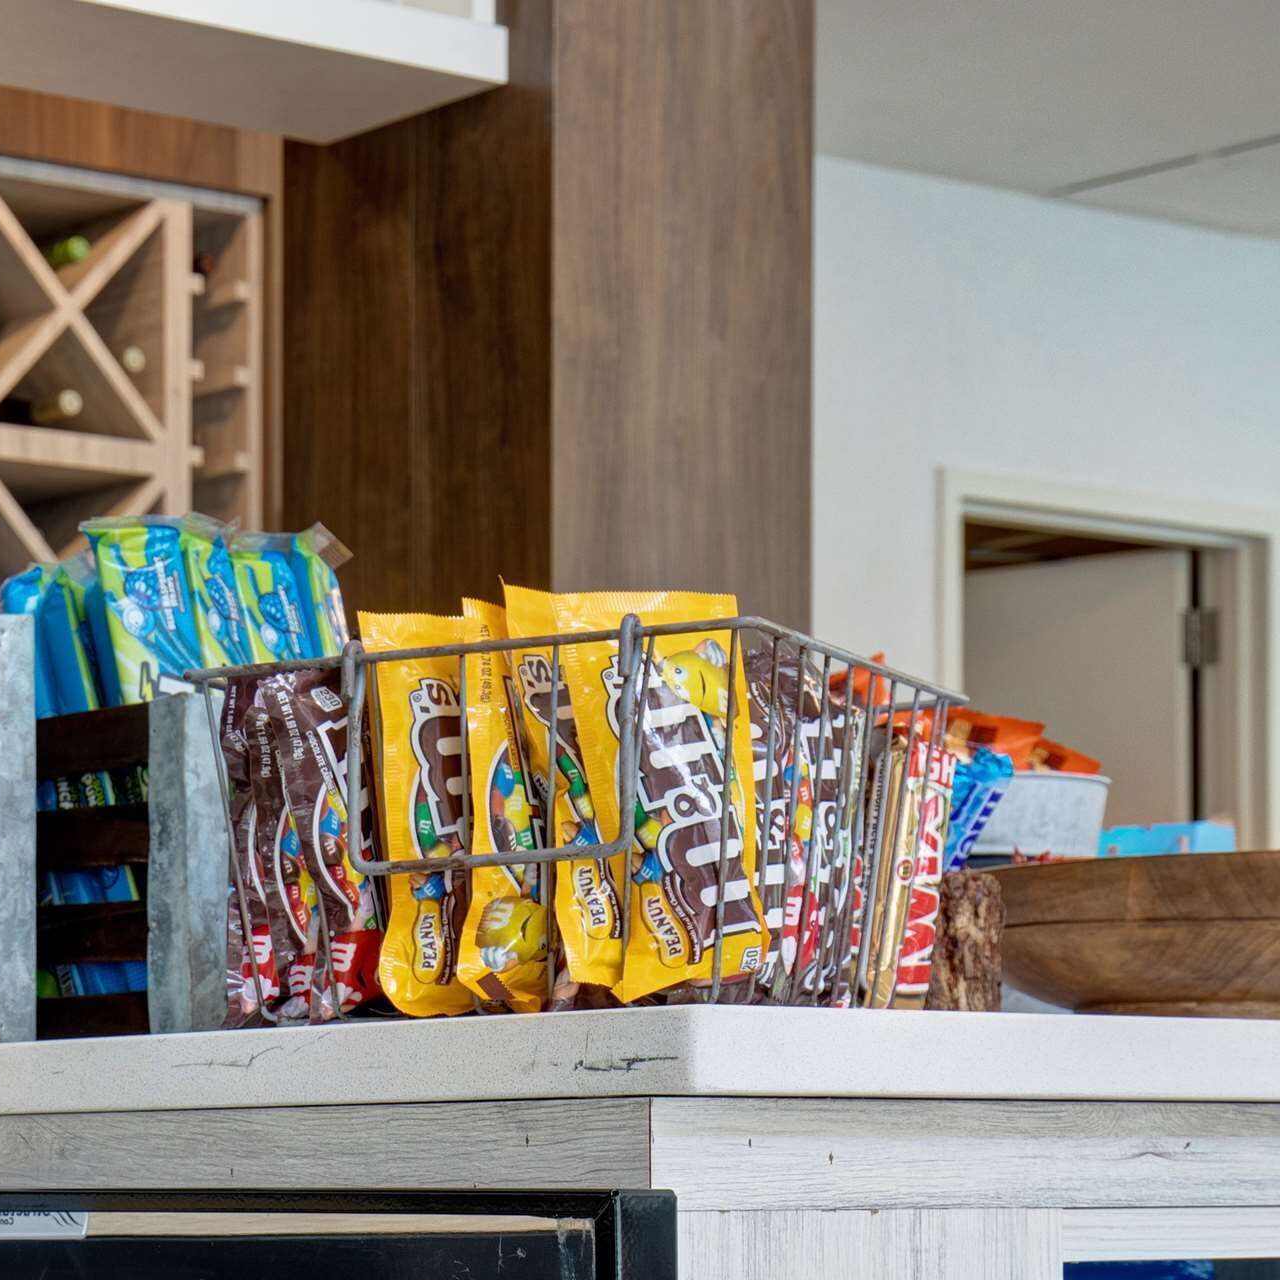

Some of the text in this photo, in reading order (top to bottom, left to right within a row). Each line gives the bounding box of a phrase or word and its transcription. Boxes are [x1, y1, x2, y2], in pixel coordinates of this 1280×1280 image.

[280, 704, 293, 716] WT
[319, 688, 339, 707] 230
[306, 730, 326, 768] CHOCOLATE
[576, 867, 606, 927] PEANUT
[421, 912, 437, 970] PEANUT
[647, 895, 681, 957] PEANUT
[742, 949, 759, 971] 250
